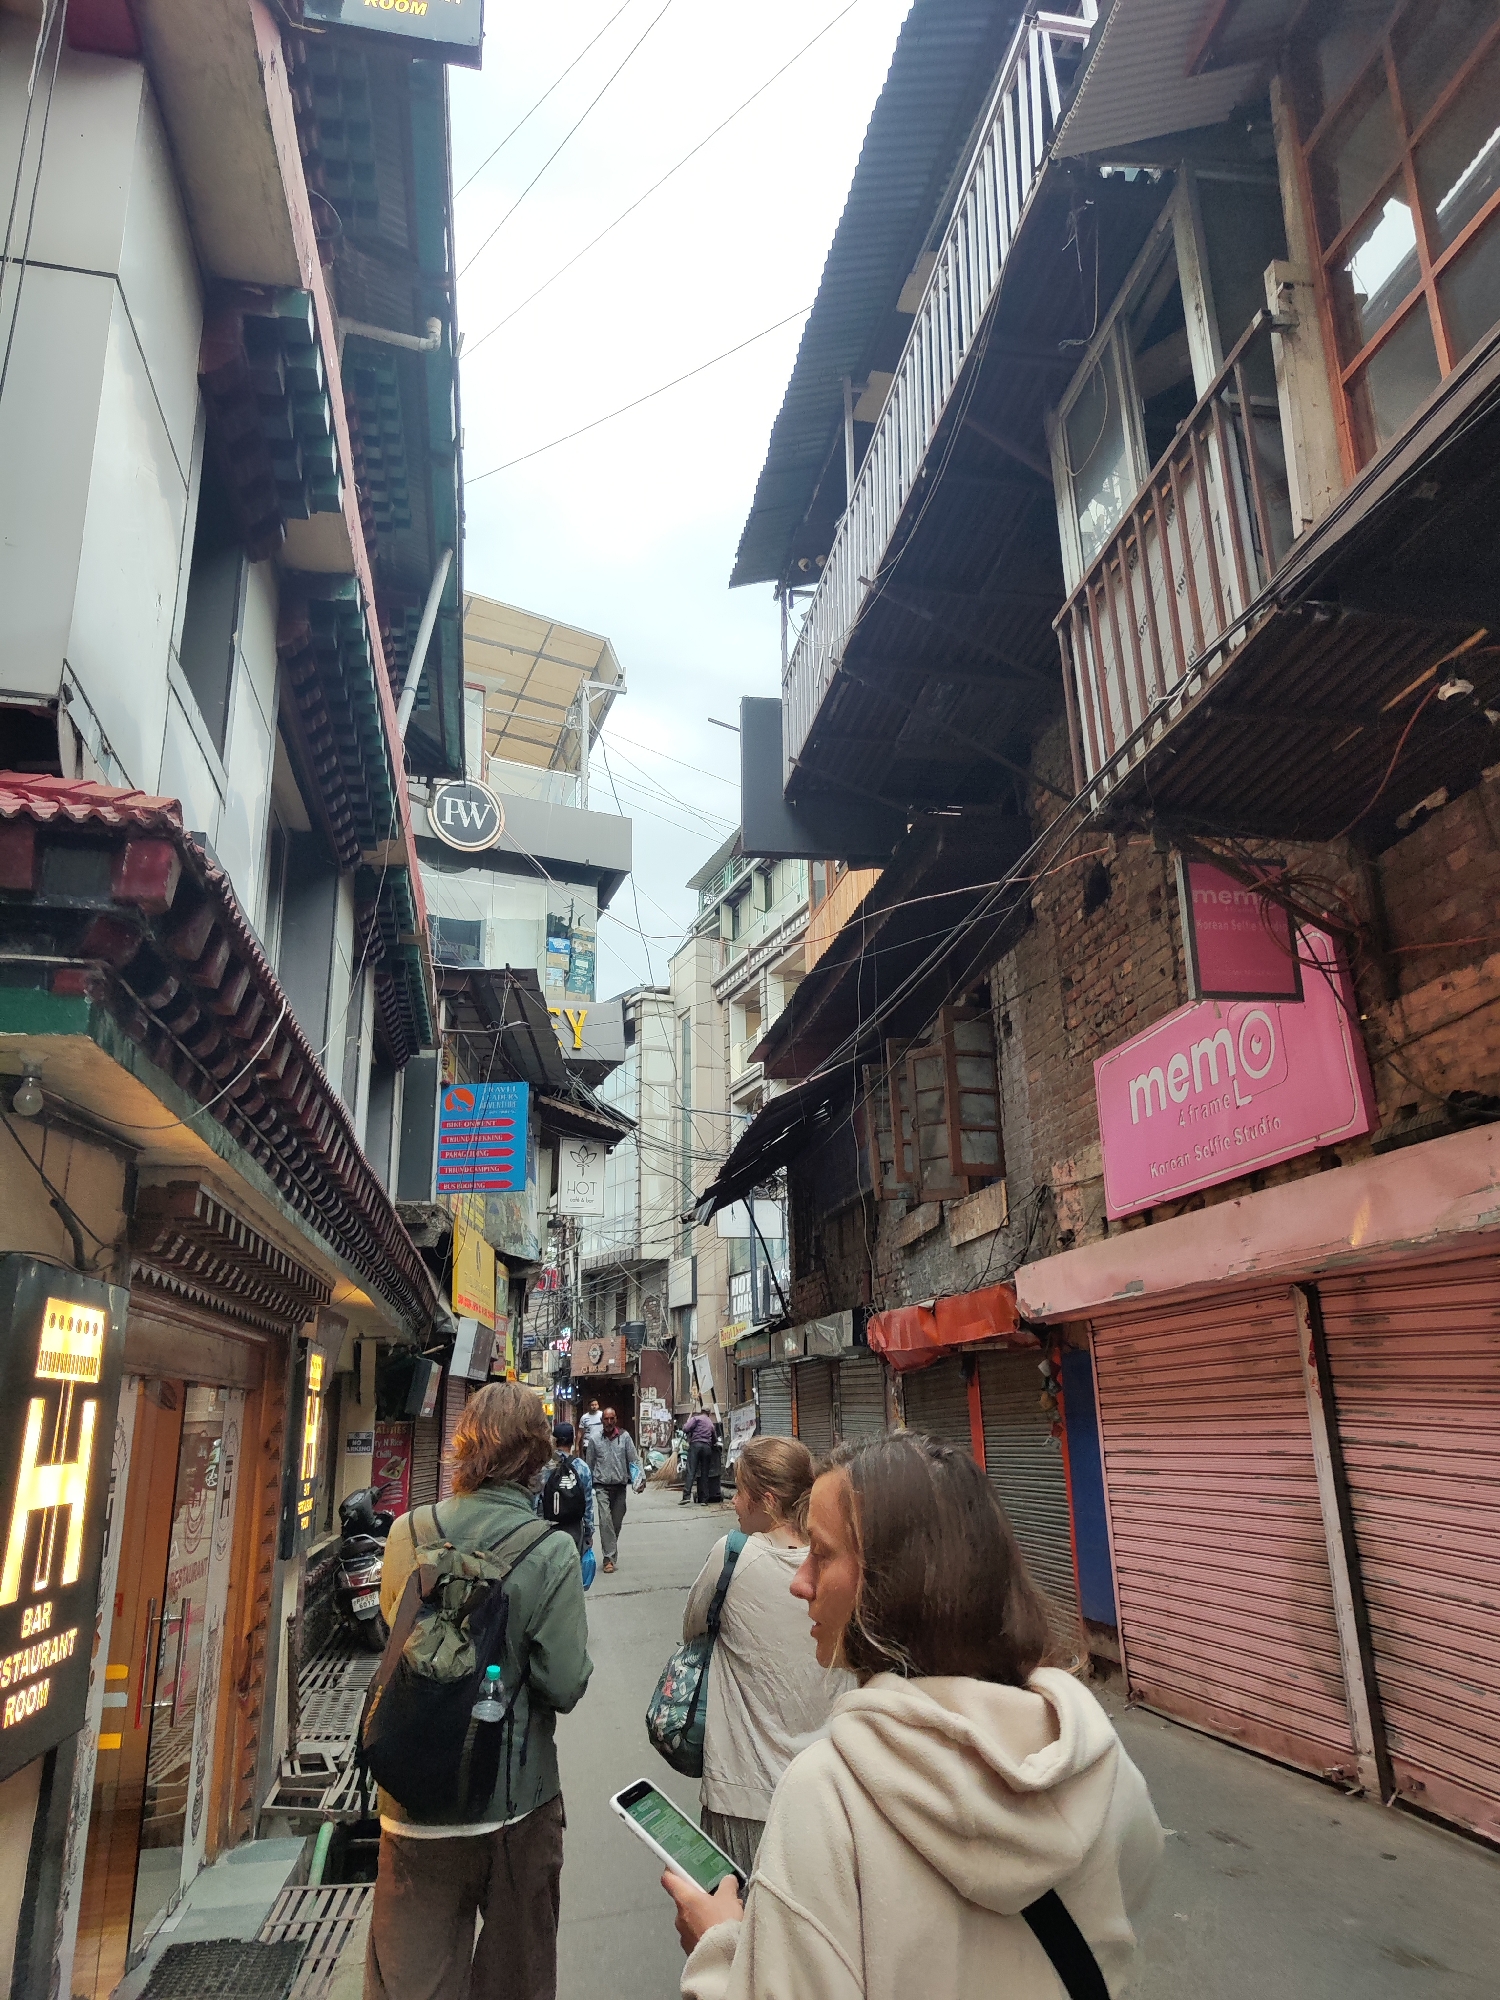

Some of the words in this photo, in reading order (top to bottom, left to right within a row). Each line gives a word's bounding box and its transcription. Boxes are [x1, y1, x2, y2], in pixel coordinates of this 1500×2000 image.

[1128, 1009, 1275, 1126] memo
[1188, 1093, 1231, 1124] frame
[1150, 1152, 1190, 1179] Korean
[1193, 1135, 1231, 1162] Selfie
[1233, 1114, 1281, 1146] Studio
[443, 1182, 456, 1190] BUS
[566, 1180, 597, 1195] HOT
[21, 1601, 53, 1639] BAR
[3, 1677, 51, 1730] ROOM
